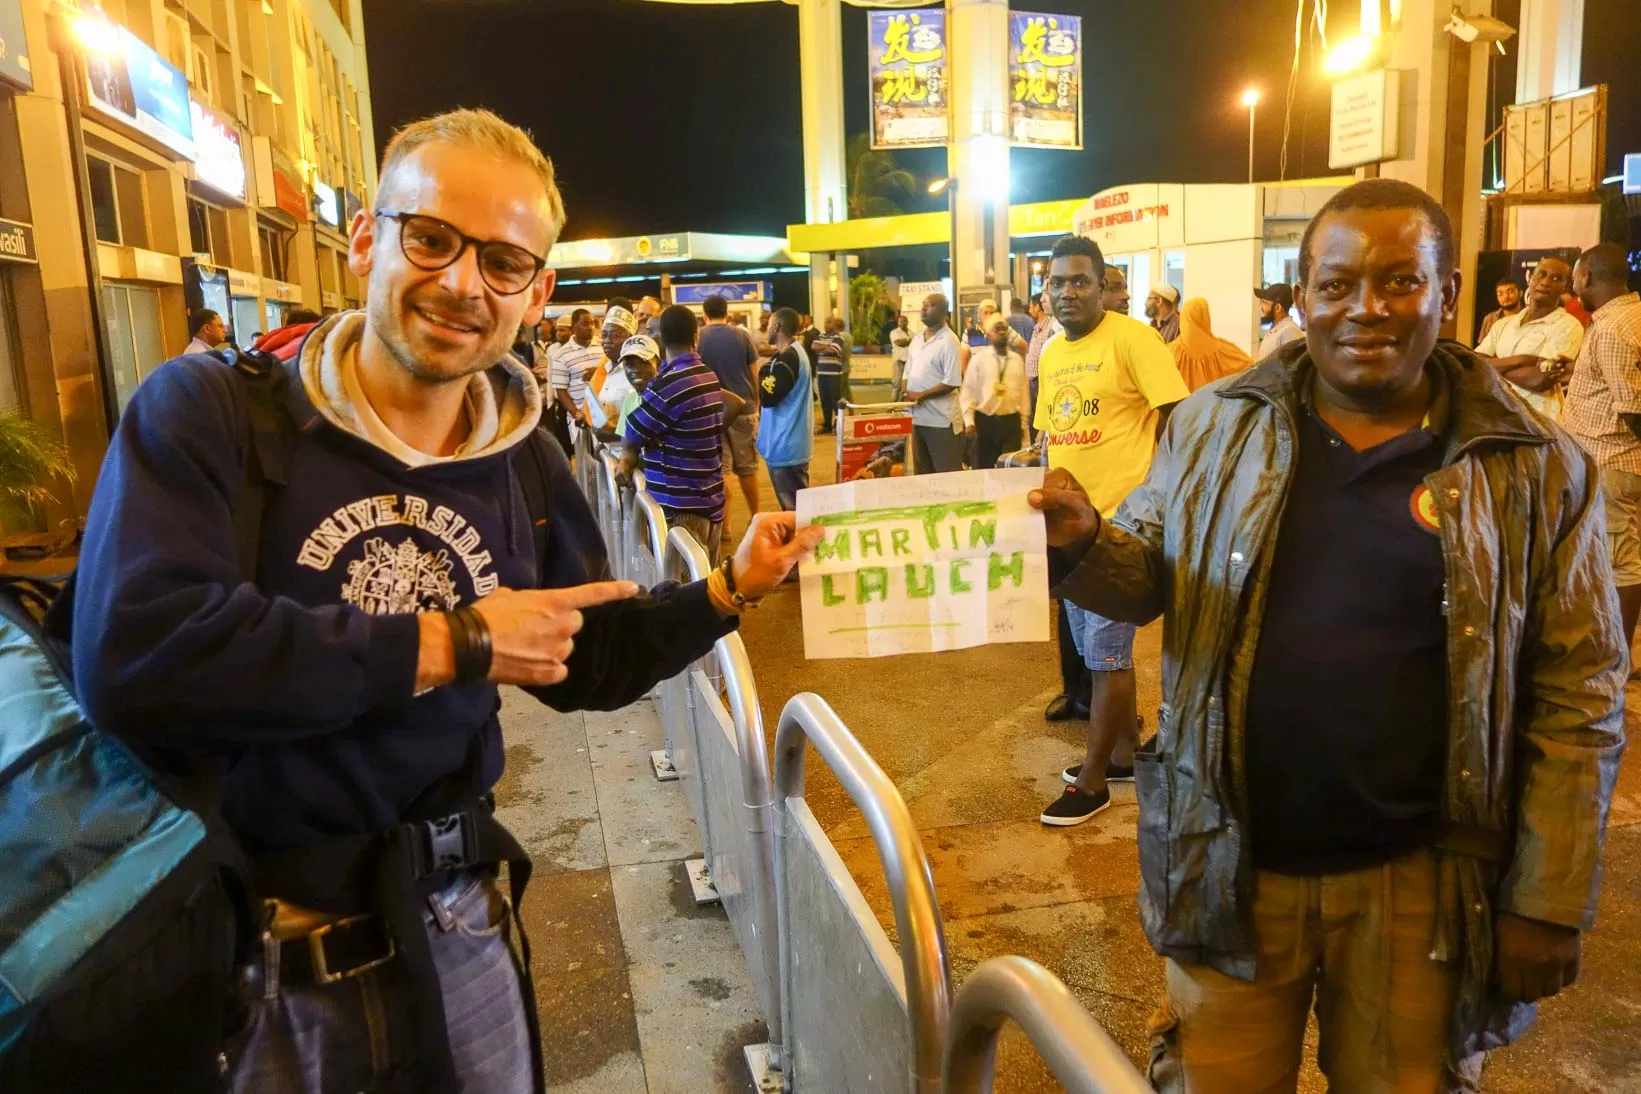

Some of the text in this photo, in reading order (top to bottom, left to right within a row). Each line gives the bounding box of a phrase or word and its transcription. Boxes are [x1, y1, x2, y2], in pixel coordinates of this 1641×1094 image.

[296, 494, 499, 598] UNIVERSIDAD
[814, 506, 997, 564] MARTIN
[822, 551, 1024, 607] LAUCH
